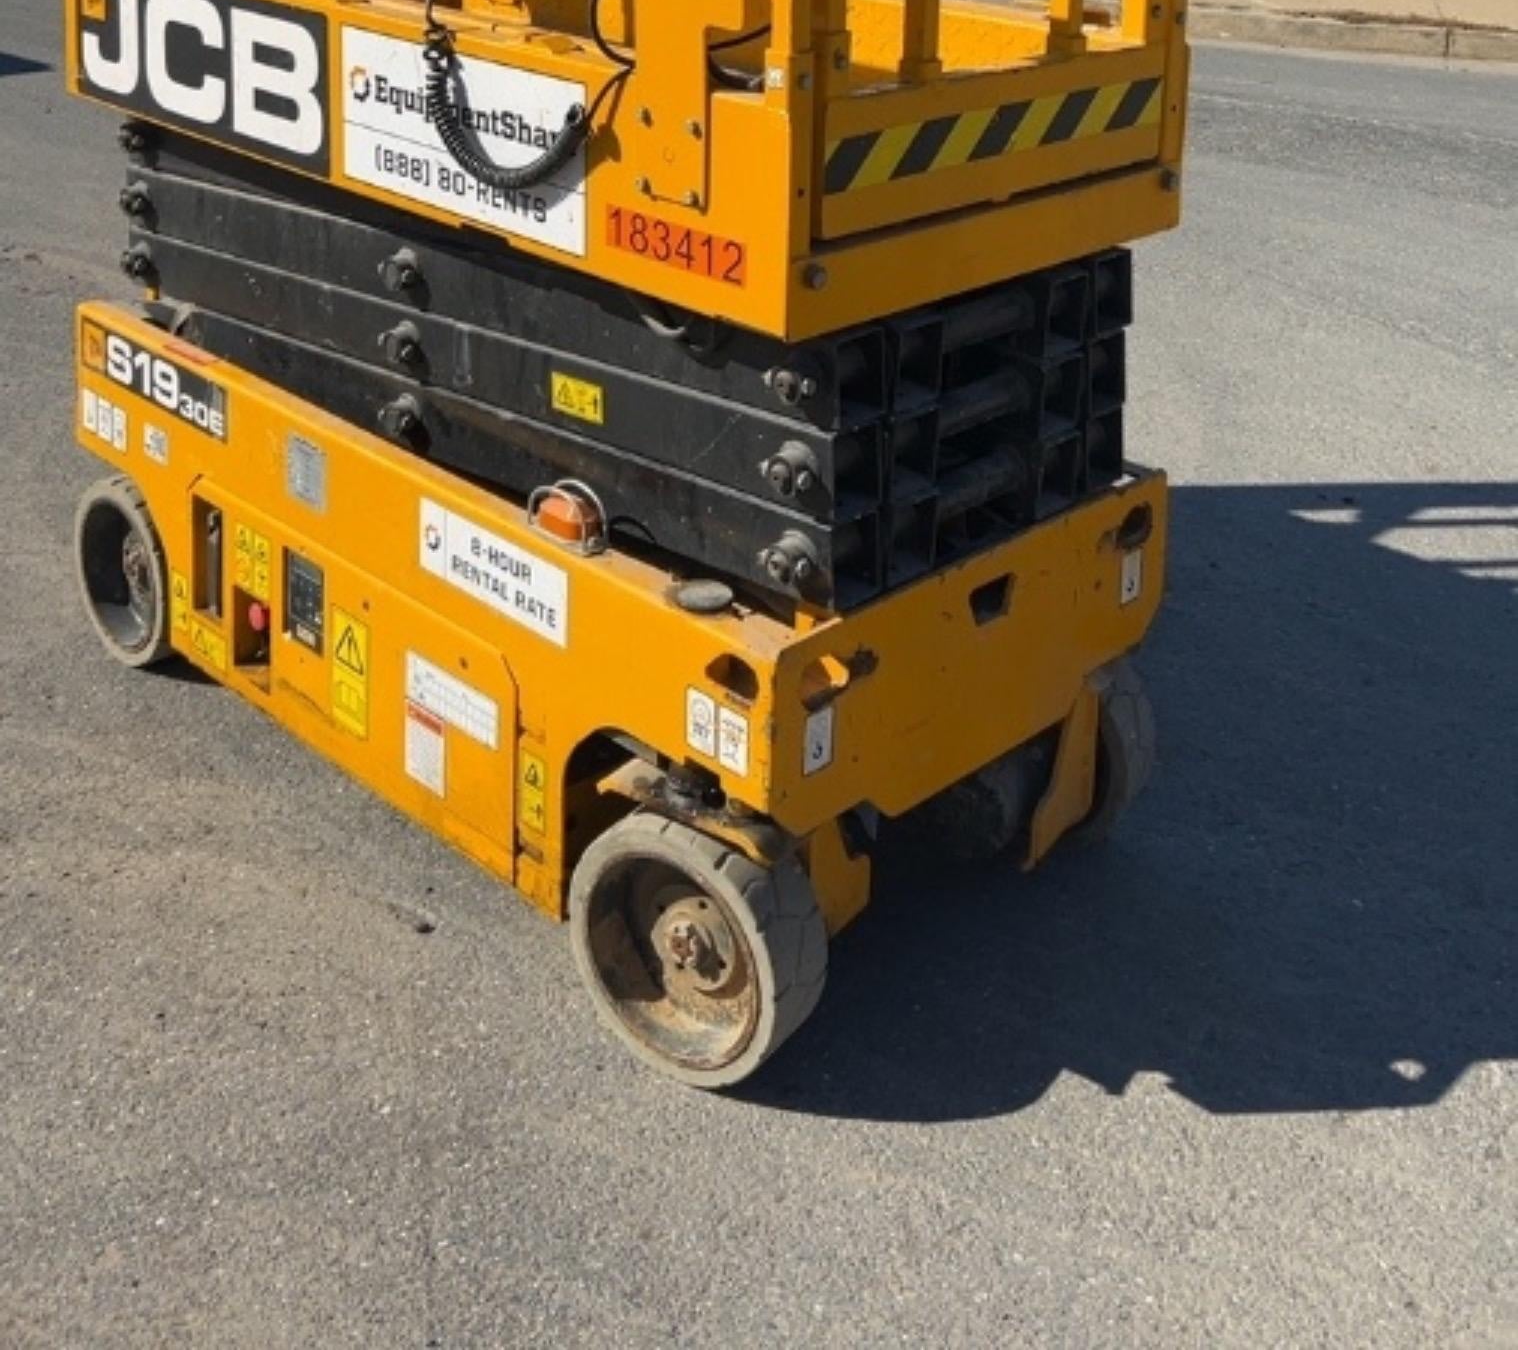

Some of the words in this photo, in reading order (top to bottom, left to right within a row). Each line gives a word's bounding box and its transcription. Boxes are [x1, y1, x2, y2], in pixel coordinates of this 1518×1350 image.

[374, 74, 562, 150] EquientShar
[608, 207, 744, 286] 183412
[451, 554, 508, 601] RENTAL
[515, 580, 557, 629] RATE
[470, 536, 532, 586] 8-HOUR
